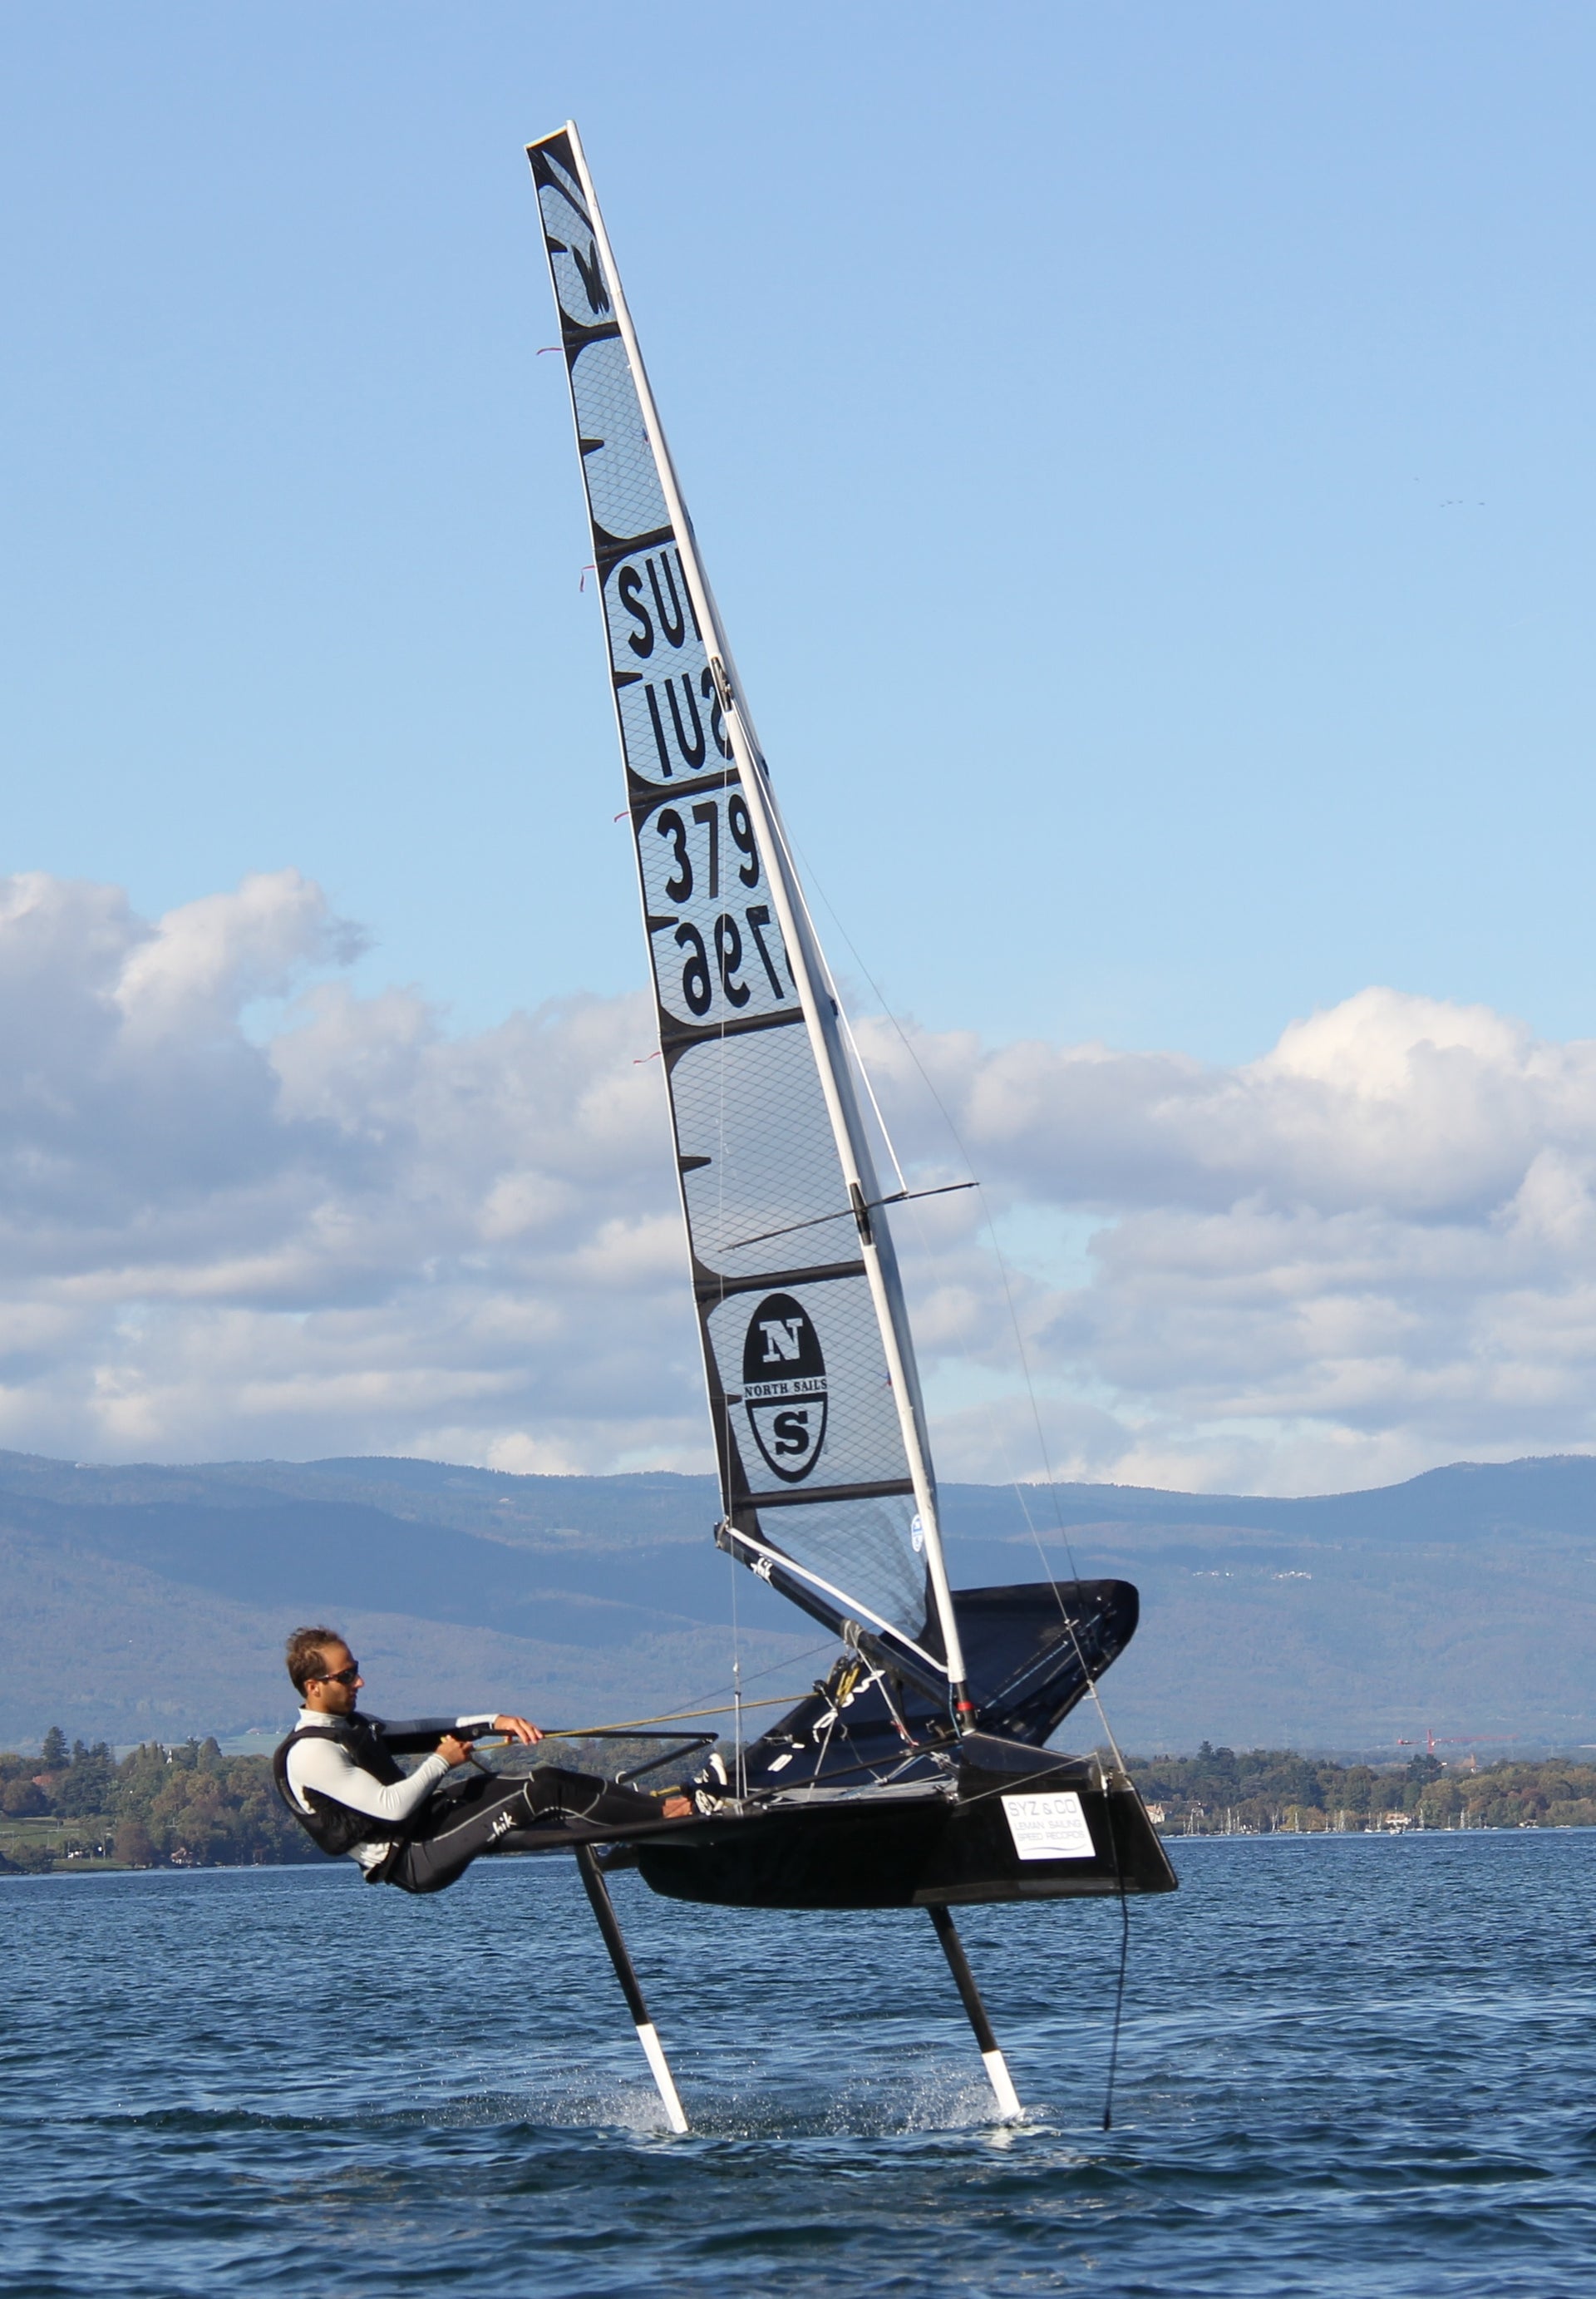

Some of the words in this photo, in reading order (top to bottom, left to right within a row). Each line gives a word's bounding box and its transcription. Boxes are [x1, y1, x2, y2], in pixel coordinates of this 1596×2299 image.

[657, 794, 760, 904] 379
[759, 1318, 804, 1364] N
[744, 1383, 789, 1399] NORTH
[794, 1379, 828, 1393] SAILS
[773, 1411, 810, 1455] S
[1008, 1802, 1040, 1817] SYZ
[1042, 1803, 1053, 1815] &
[1054, 1799, 1076, 1814] CO
[1048, 1820, 1081, 1828] SAILING
[1018, 1833, 1042, 1842] SPEED
[1046, 1832, 1085, 1840] RECORDS
